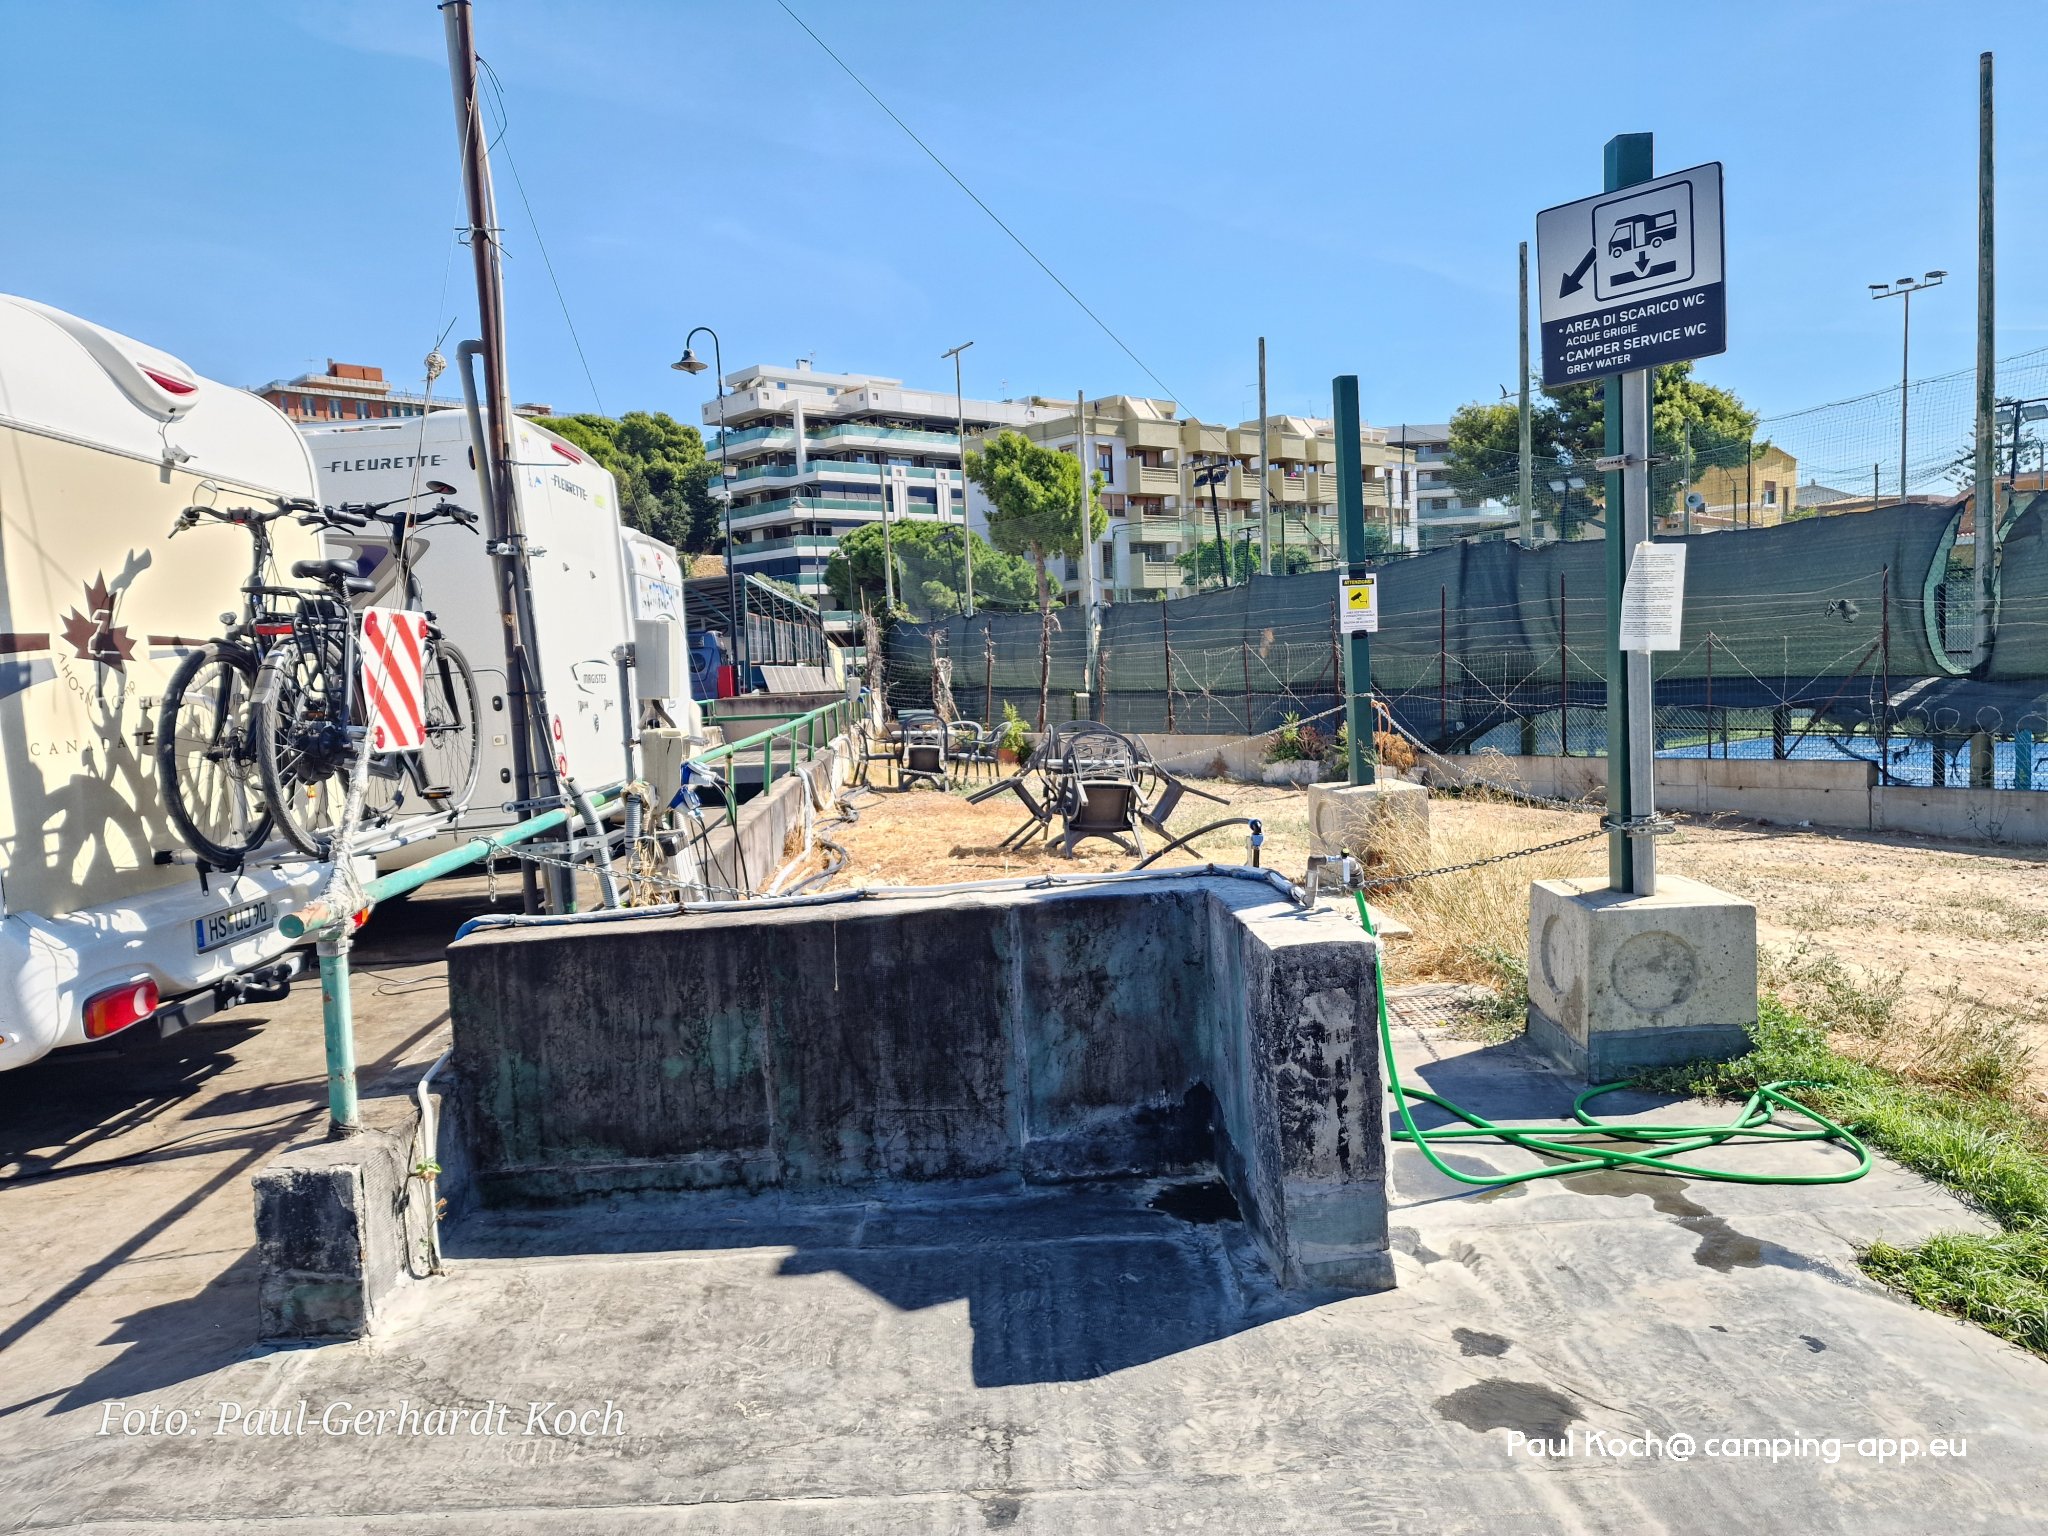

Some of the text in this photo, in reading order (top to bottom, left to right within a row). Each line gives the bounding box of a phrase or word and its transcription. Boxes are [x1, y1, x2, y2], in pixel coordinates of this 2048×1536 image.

[1565, 293, 1705, 335] AREA DI SCARICO WC
[1566, 323, 1638, 347] ACQUE GRIGIE
[1566, 322, 1707, 362] CAMPER SERVICE WC
[1567, 353, 1631, 375] GREY WATER
[331, 454, 441, 473] FLEURETTE
[58, 652, 94, 707] AHORN
[30, 737, 127, 756] CANADA
[209, 915, 227, 941] HS
